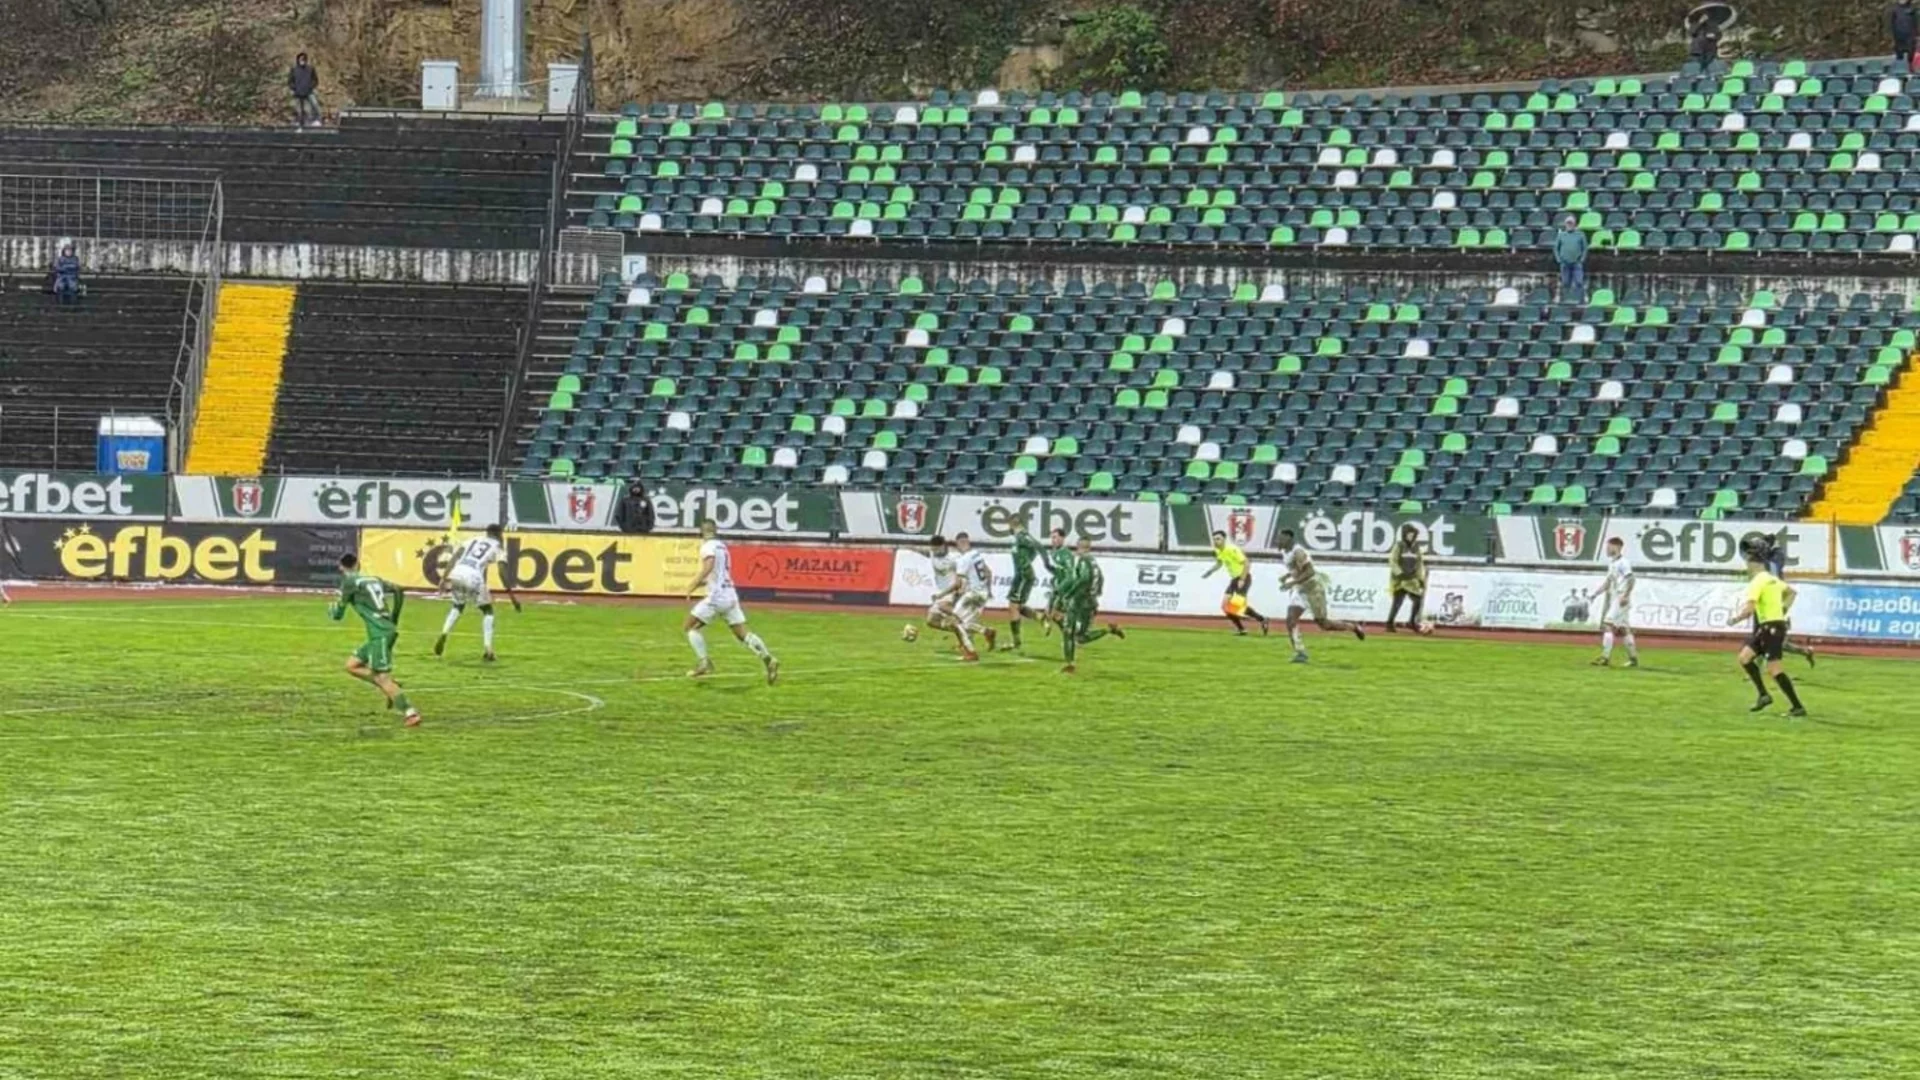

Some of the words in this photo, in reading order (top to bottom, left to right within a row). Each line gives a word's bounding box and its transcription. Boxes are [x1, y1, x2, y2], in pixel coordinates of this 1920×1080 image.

[0, 474, 133, 514] fbet
[318, 481, 471, 522] efbet
[60, 525, 277, 582] efbet
[422, 536, 632, 593] ebet
[465, 539, 492, 560] 13
[785, 556, 865, 574] MAZALAT
[1137, 564, 1180, 585] EG
[1487, 600, 1538, 616] ПОТОКА
